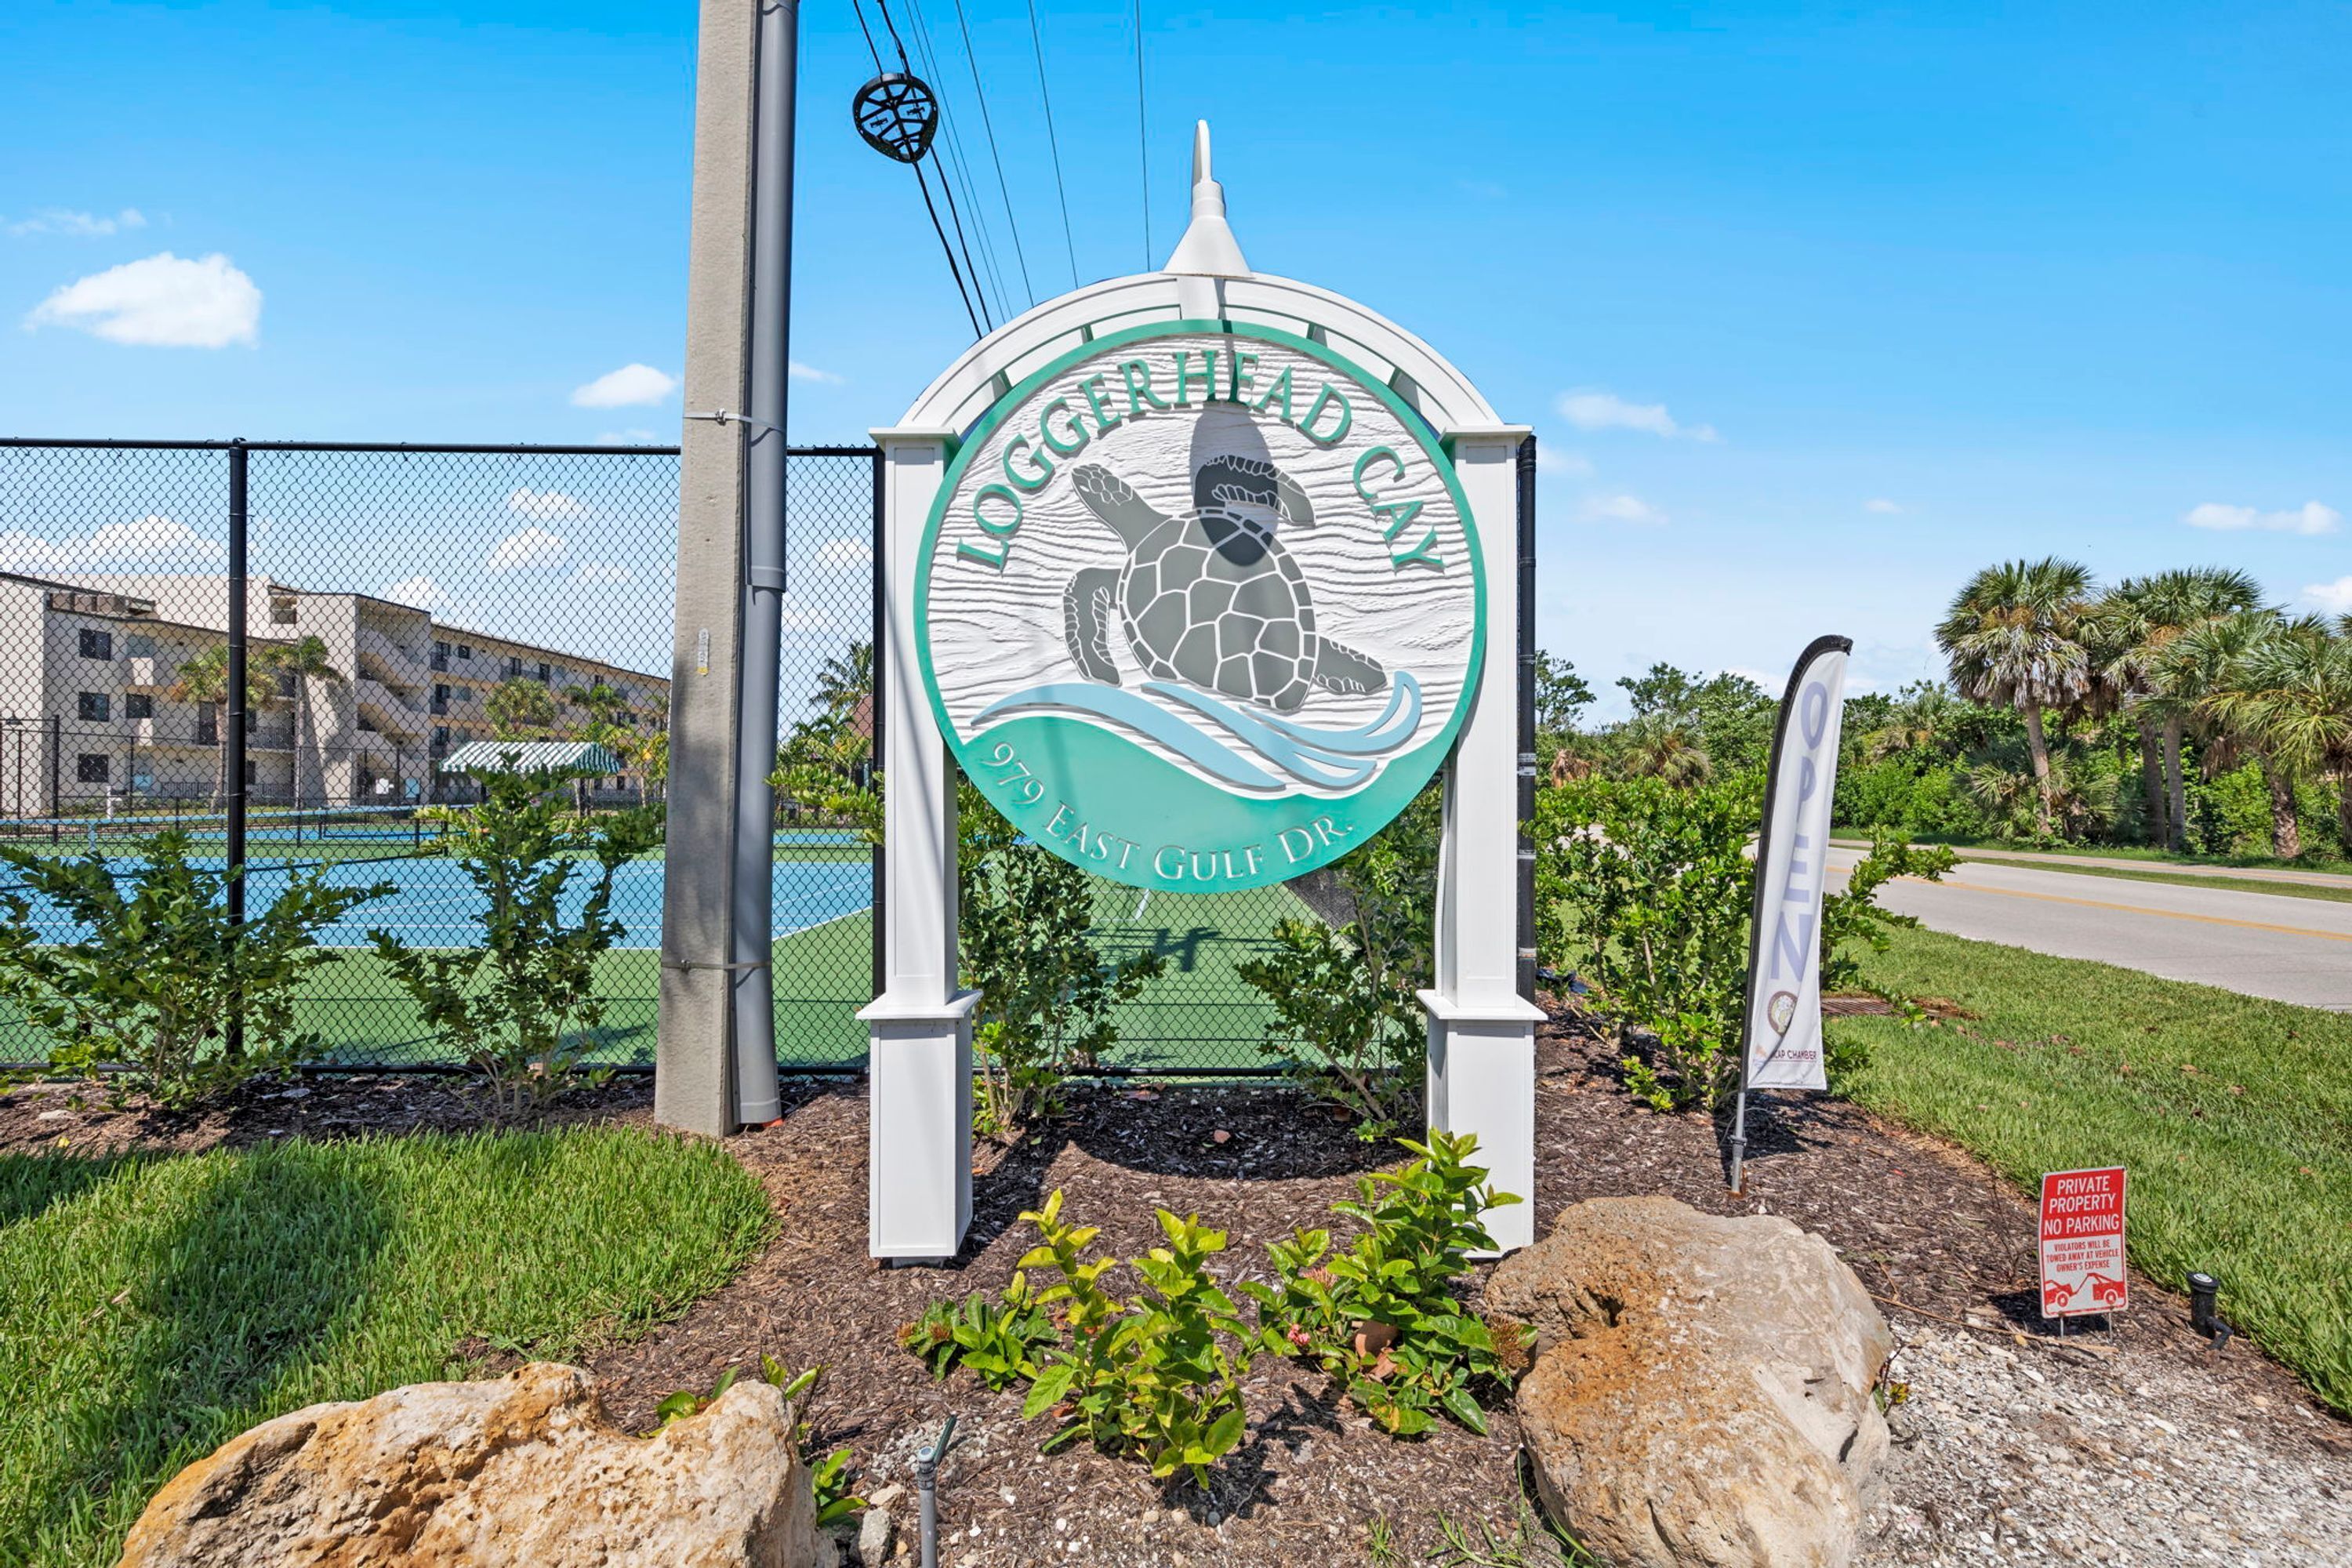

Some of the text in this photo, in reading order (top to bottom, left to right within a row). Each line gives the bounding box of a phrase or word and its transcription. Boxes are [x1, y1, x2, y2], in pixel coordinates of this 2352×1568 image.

[956, 350, 1445, 575] LOGGERHEAD CAY
[980, 742, 1354, 881] 979 EAST GULF DR.
[1770, 681, 1828, 982] OPEN
[1788, 1050, 1817, 1060] CHAMBER
[2057, 1176, 2111, 1196] PRIVATE
[2049, 1193, 2116, 1214] PROPERTY
[2044, 1214, 2120, 1236] NO PARKING
[2046, 1254, 2066, 1263] TOWED
[2067, 1252, 2085, 1261] AWAY
[2095, 1248, 2119, 1258] VEHICLE
[2054, 1242, 2085, 1252] VIOLATORS
[2056, 1260, 2110, 1272] OWNER'S EXPENSE
